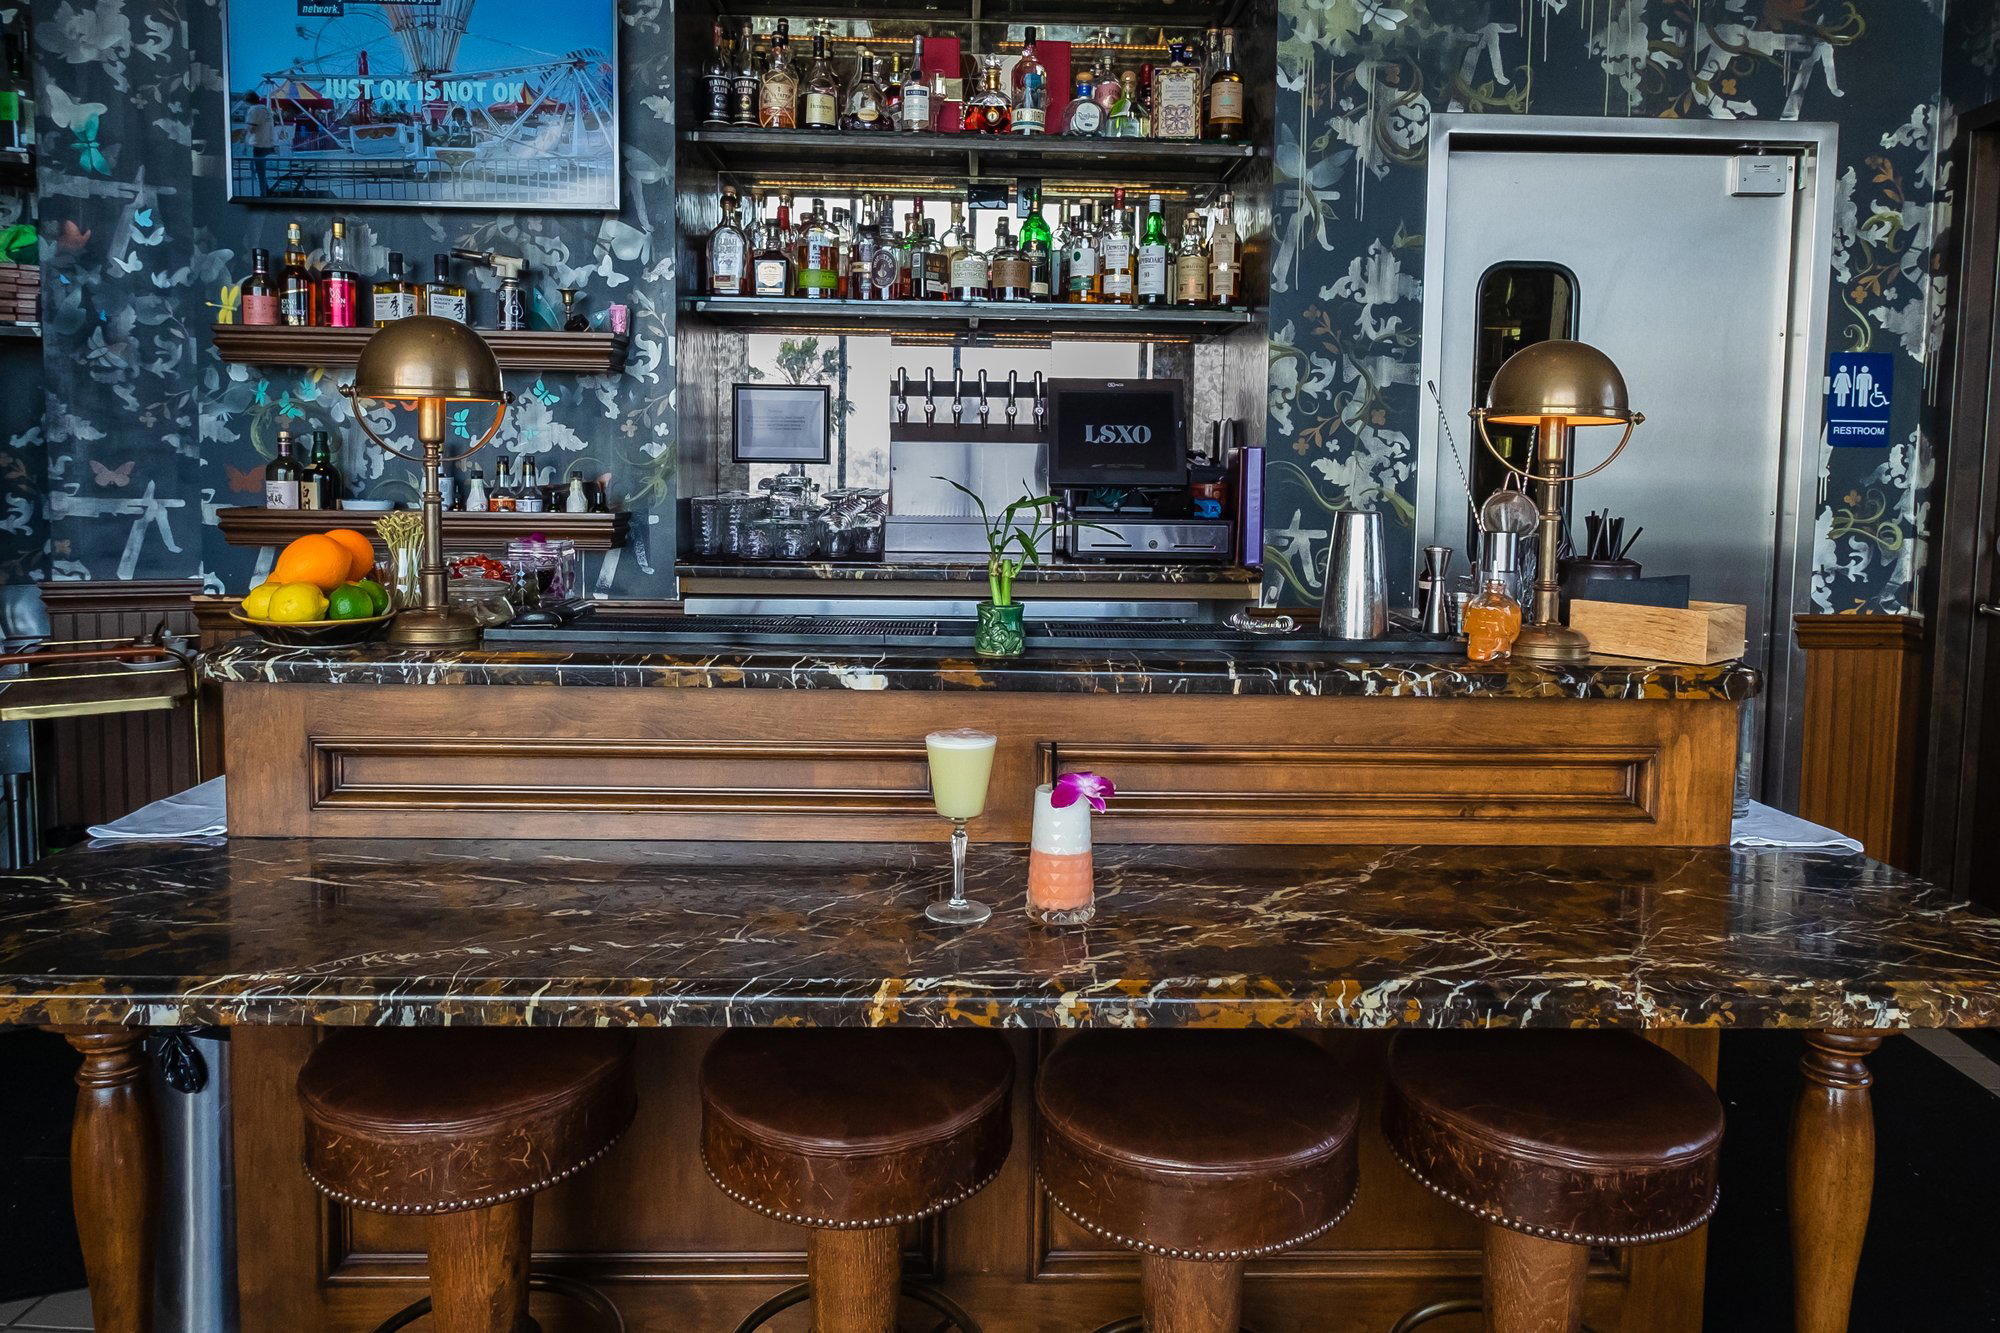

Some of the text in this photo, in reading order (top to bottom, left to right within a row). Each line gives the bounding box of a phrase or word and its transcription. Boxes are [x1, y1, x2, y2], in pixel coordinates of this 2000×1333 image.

[302, 4, 340, 14] network.
[322, 78, 524, 103] JUST OK IS NOT OK
[1085, 424, 1152, 444] LSXO
[1833, 426, 1886, 436] RESTROOM
